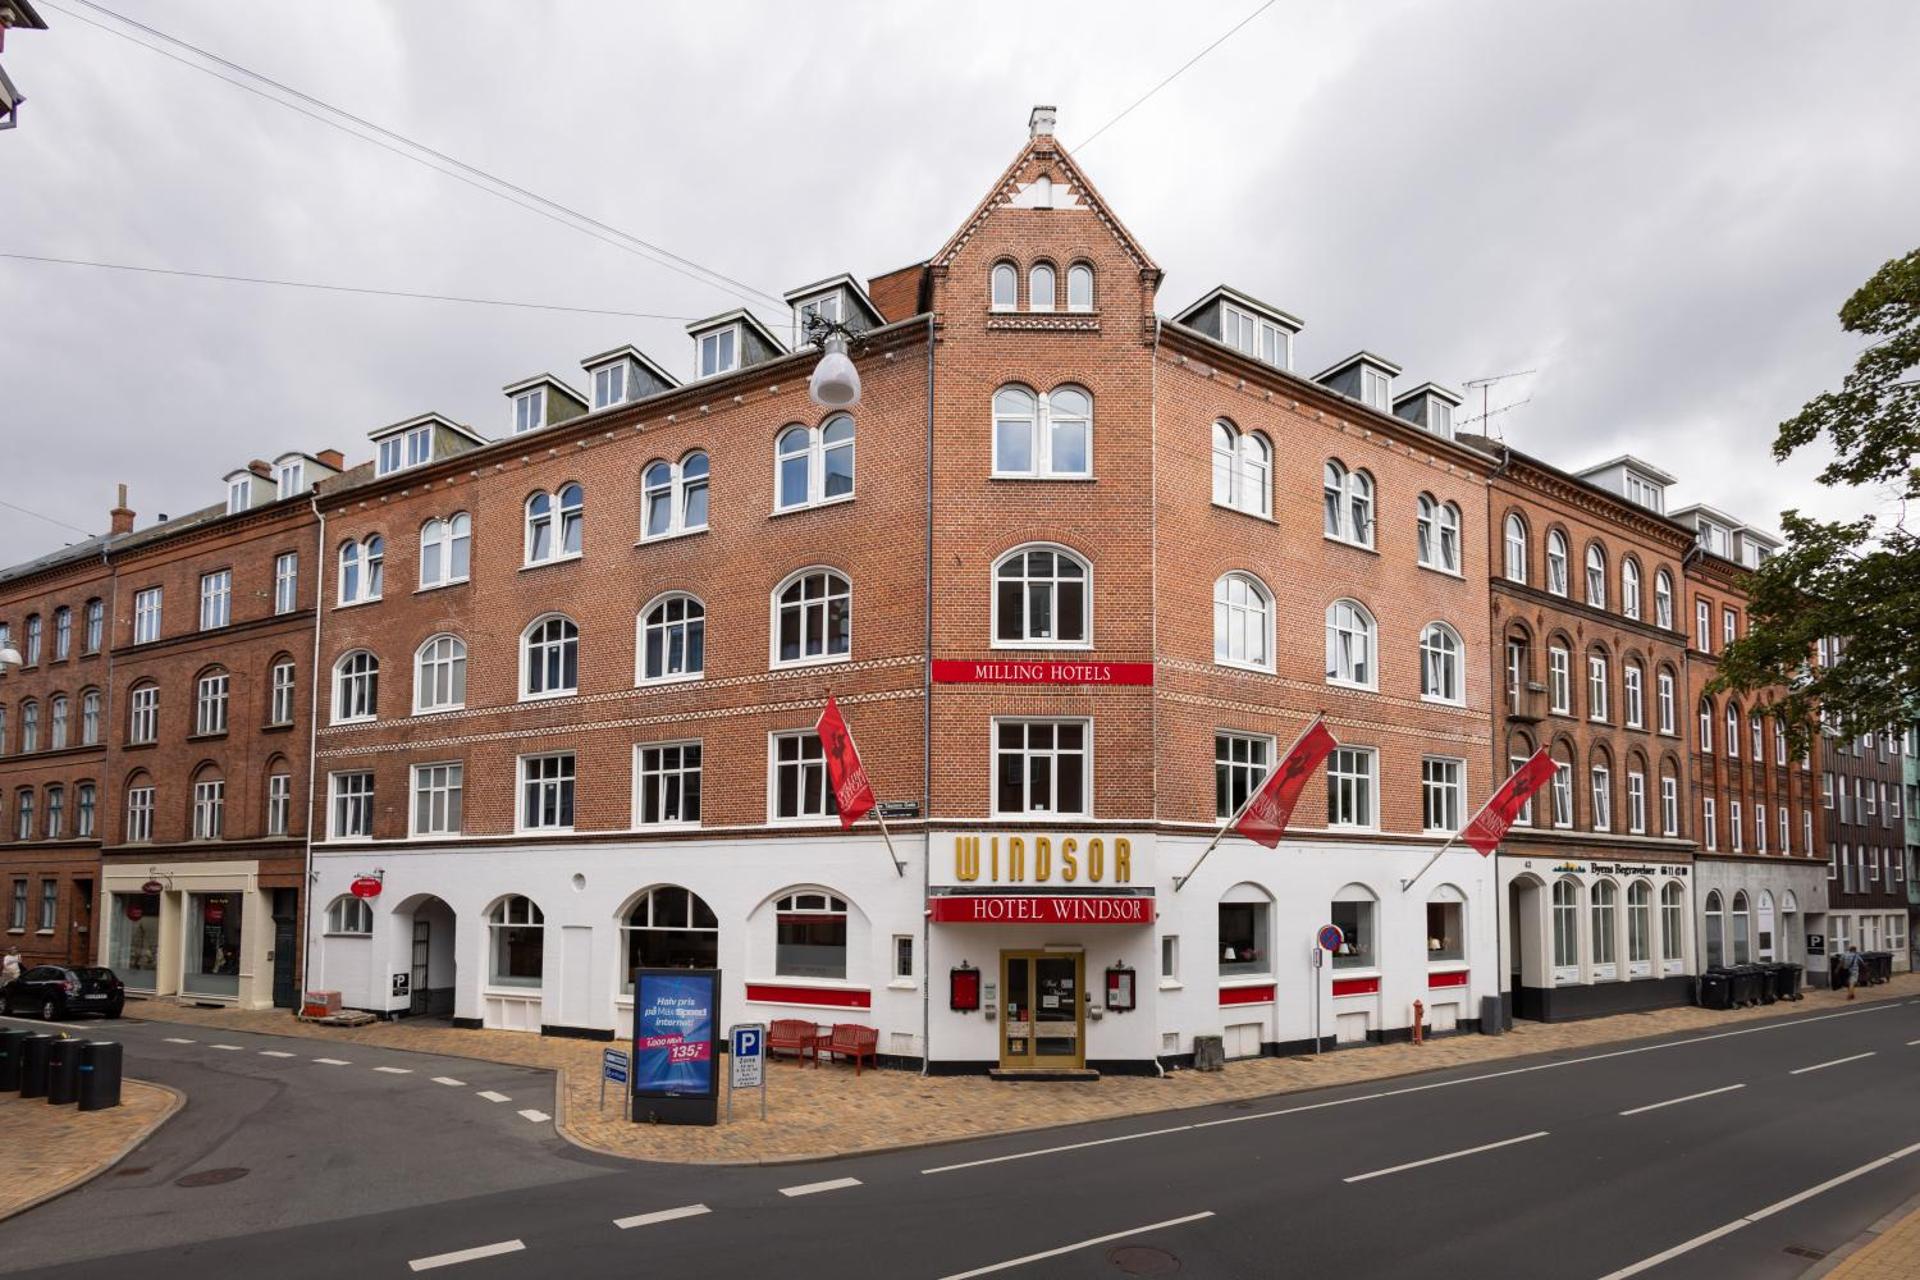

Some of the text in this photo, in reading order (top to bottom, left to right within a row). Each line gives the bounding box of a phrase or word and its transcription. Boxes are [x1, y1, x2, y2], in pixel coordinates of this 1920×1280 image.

[975, 665, 1111, 681] MILLING HOTELS
[955, 836, 1131, 882] WINDSOR
[974, 900, 1142, 920] HOTEL WINDSOR
[1811, 936, 1821, 946] P
[657, 998, 695, 1007] Halv pris
[645, 1006, 657, 1017] på
[742, 1033, 755, 1054] P
